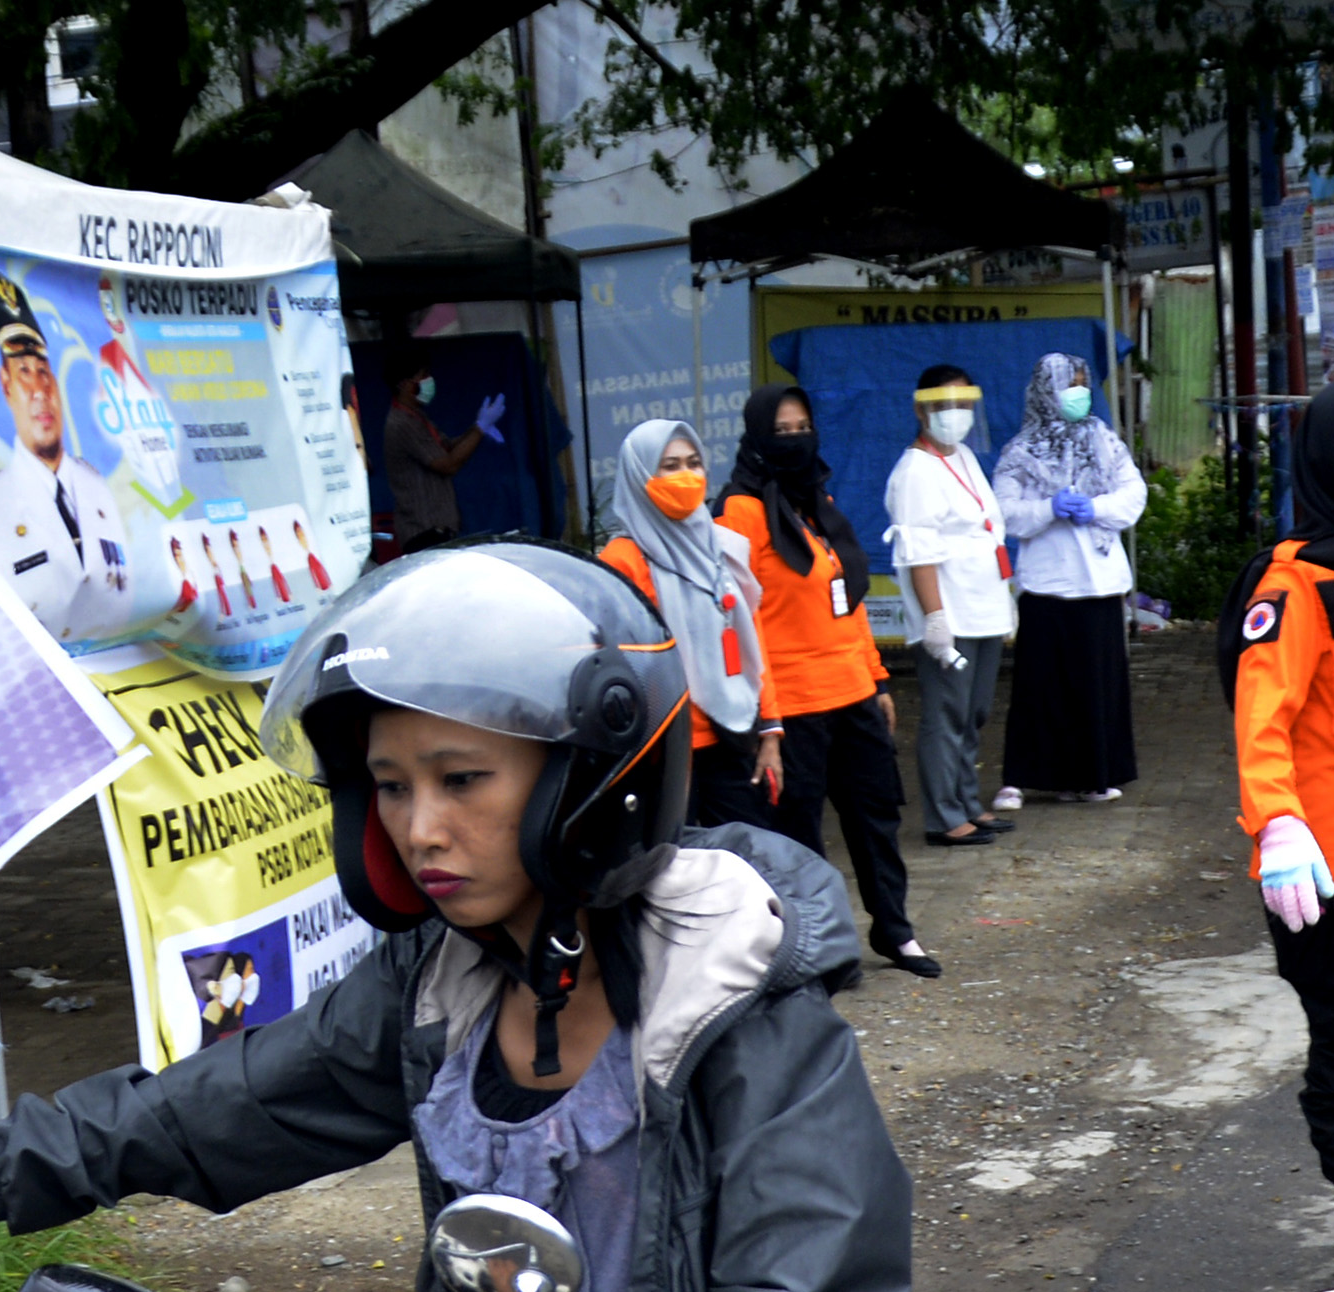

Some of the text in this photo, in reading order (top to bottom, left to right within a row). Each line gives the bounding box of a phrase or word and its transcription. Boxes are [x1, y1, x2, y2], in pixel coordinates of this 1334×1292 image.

[79, 213, 223, 268] KEC. RAPPOCINI
[125, 278, 258, 316] POSKO TERPADU
[98, 367, 175, 451] Stay
[321, 646, 390, 672] HONDA
[149, 690, 266, 778] CHECK
[140, 780, 284, 868] PEMBATASAN
[255, 841, 295, 889] PSBB
[290, 827, 324, 872] KOTA
[293, 898, 331, 952] PAKAI
